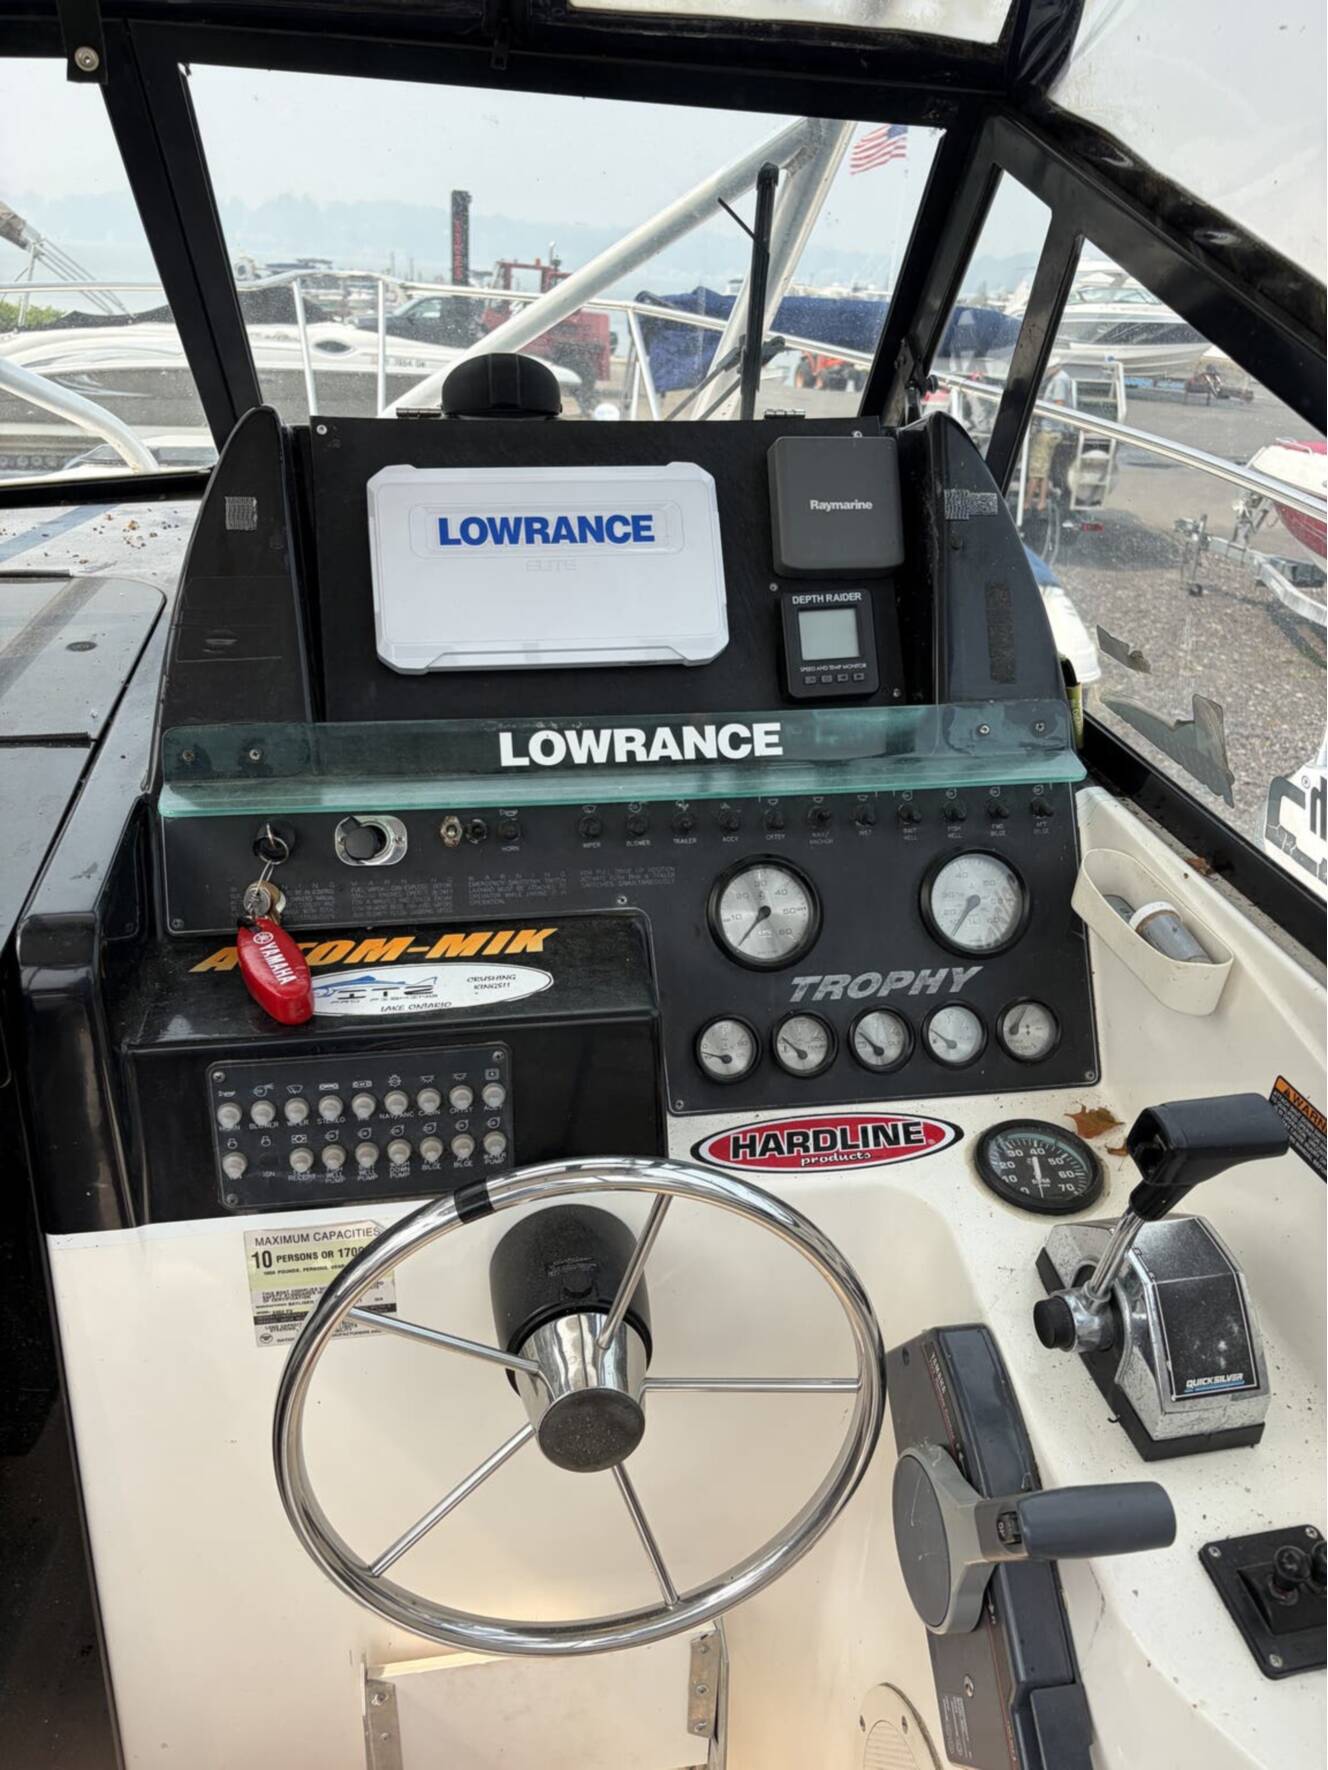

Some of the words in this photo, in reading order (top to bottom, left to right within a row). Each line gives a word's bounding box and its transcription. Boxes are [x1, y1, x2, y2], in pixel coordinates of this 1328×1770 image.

[809, 499, 873, 512] Raymarine
[438, 515, 655, 546] LOWRANCE
[792, 594, 825, 605] DEPTH
[826, 592, 862, 602] RAIDER
[816, 664, 828, 672] AND
[842, 662, 867, 670] MONITOR
[499, 722, 783, 767] LOWRANCE
[259, 942, 298, 985] YAMAHA
[467, 974, 516, 984] CRUSHING
[790, 966, 984, 1002] TROPHY
[380, 1003, 402, 1013] LAKE
[407, 1001, 452, 1011] ONTARIO
[730, 1121, 925, 1161] HARDLINE
[1007, 1149, 1024, 1158] 30
[1030, 1147, 1046, 1156] 40
[800, 1151, 872, 1167] products
[999, 1161, 1016, 1170] 20
[1048, 1157, 1065, 1167] 50
[1001, 1174, 1018, 1184] 10
[1058, 1170, 1076, 1179] 60
[1058, 1183, 1076, 1192] 70
[255, 1233, 310, 1247] MAXIMUM
[313, 1227, 381, 1242] CAPACITIES
[251, 1250, 273, 1269] 10
[276, 1251, 319, 1263] PERSONS
[321, 1250, 335, 1260] OR
[1186, 1373, 1244, 1389] QUICKSILVER
